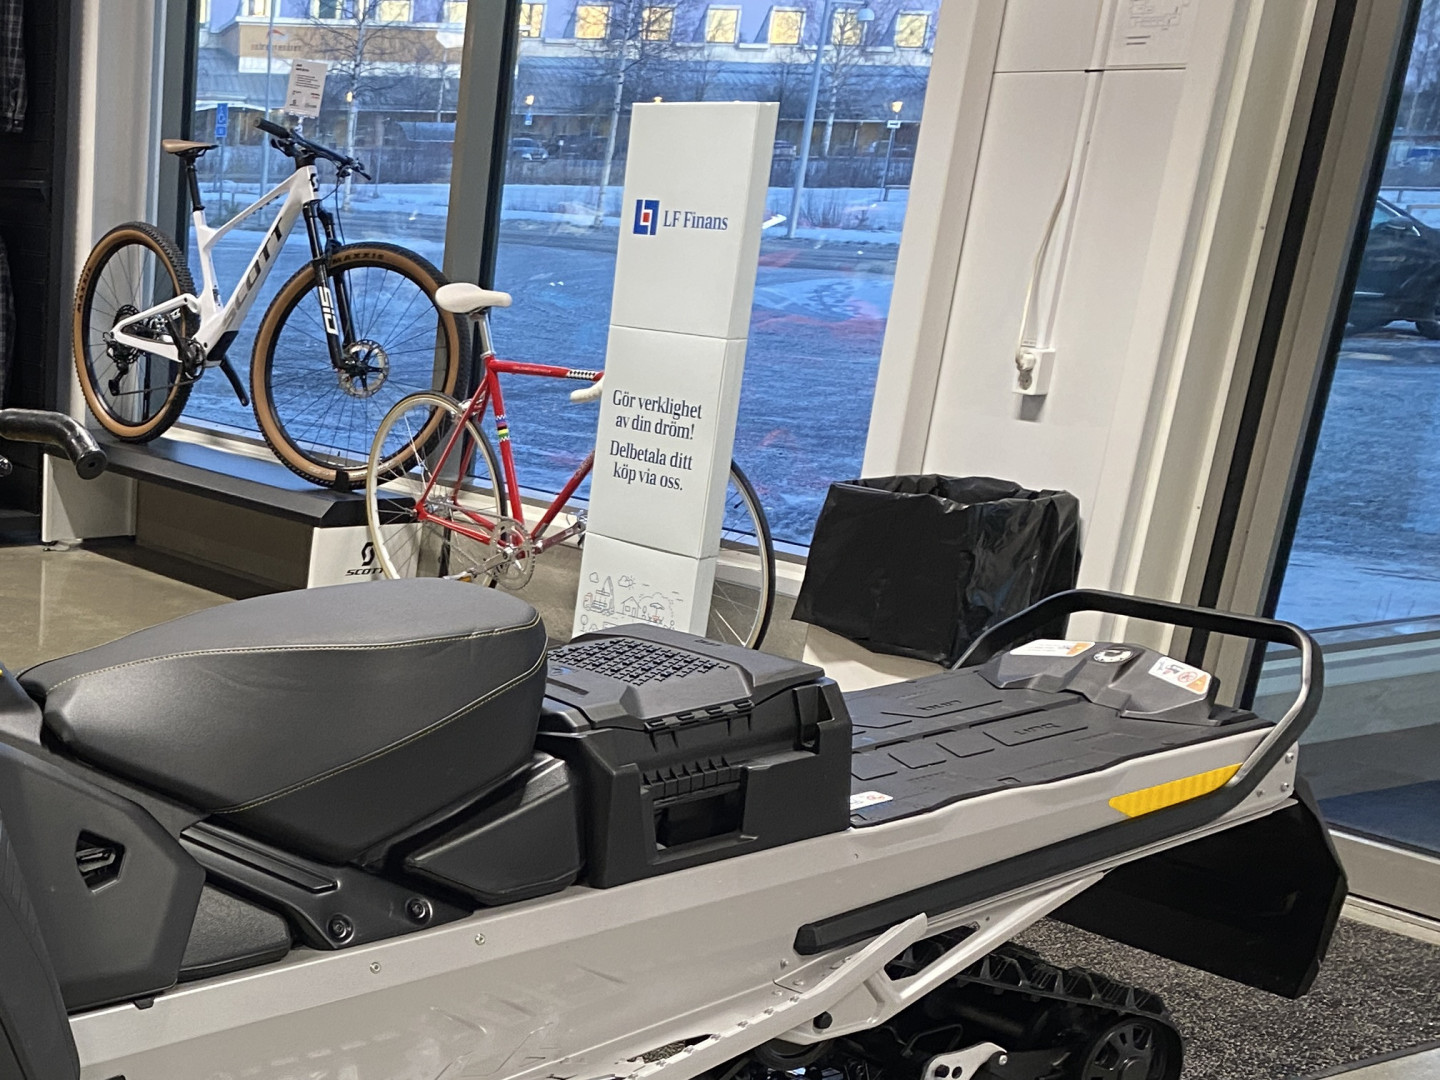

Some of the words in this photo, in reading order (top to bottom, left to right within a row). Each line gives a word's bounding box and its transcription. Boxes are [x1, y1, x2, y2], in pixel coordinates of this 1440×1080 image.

[663, 210, 681, 227] LF
[683, 211, 728, 230] Finans
[223, 216, 283, 330] SCOTT
[612, 389, 636, 408] Gör
[638, 396, 702, 420] verklighet
[615, 415, 630, 428] av
[631, 414, 652, 433] din
[654, 418, 695, 440] dröm!
[609, 440, 667, 466] Delbetala
[669, 451, 693, 471] ditt
[613, 461, 637, 485] köp
[638, 468, 657, 486] via
[659, 475, 683, 491] oss.
